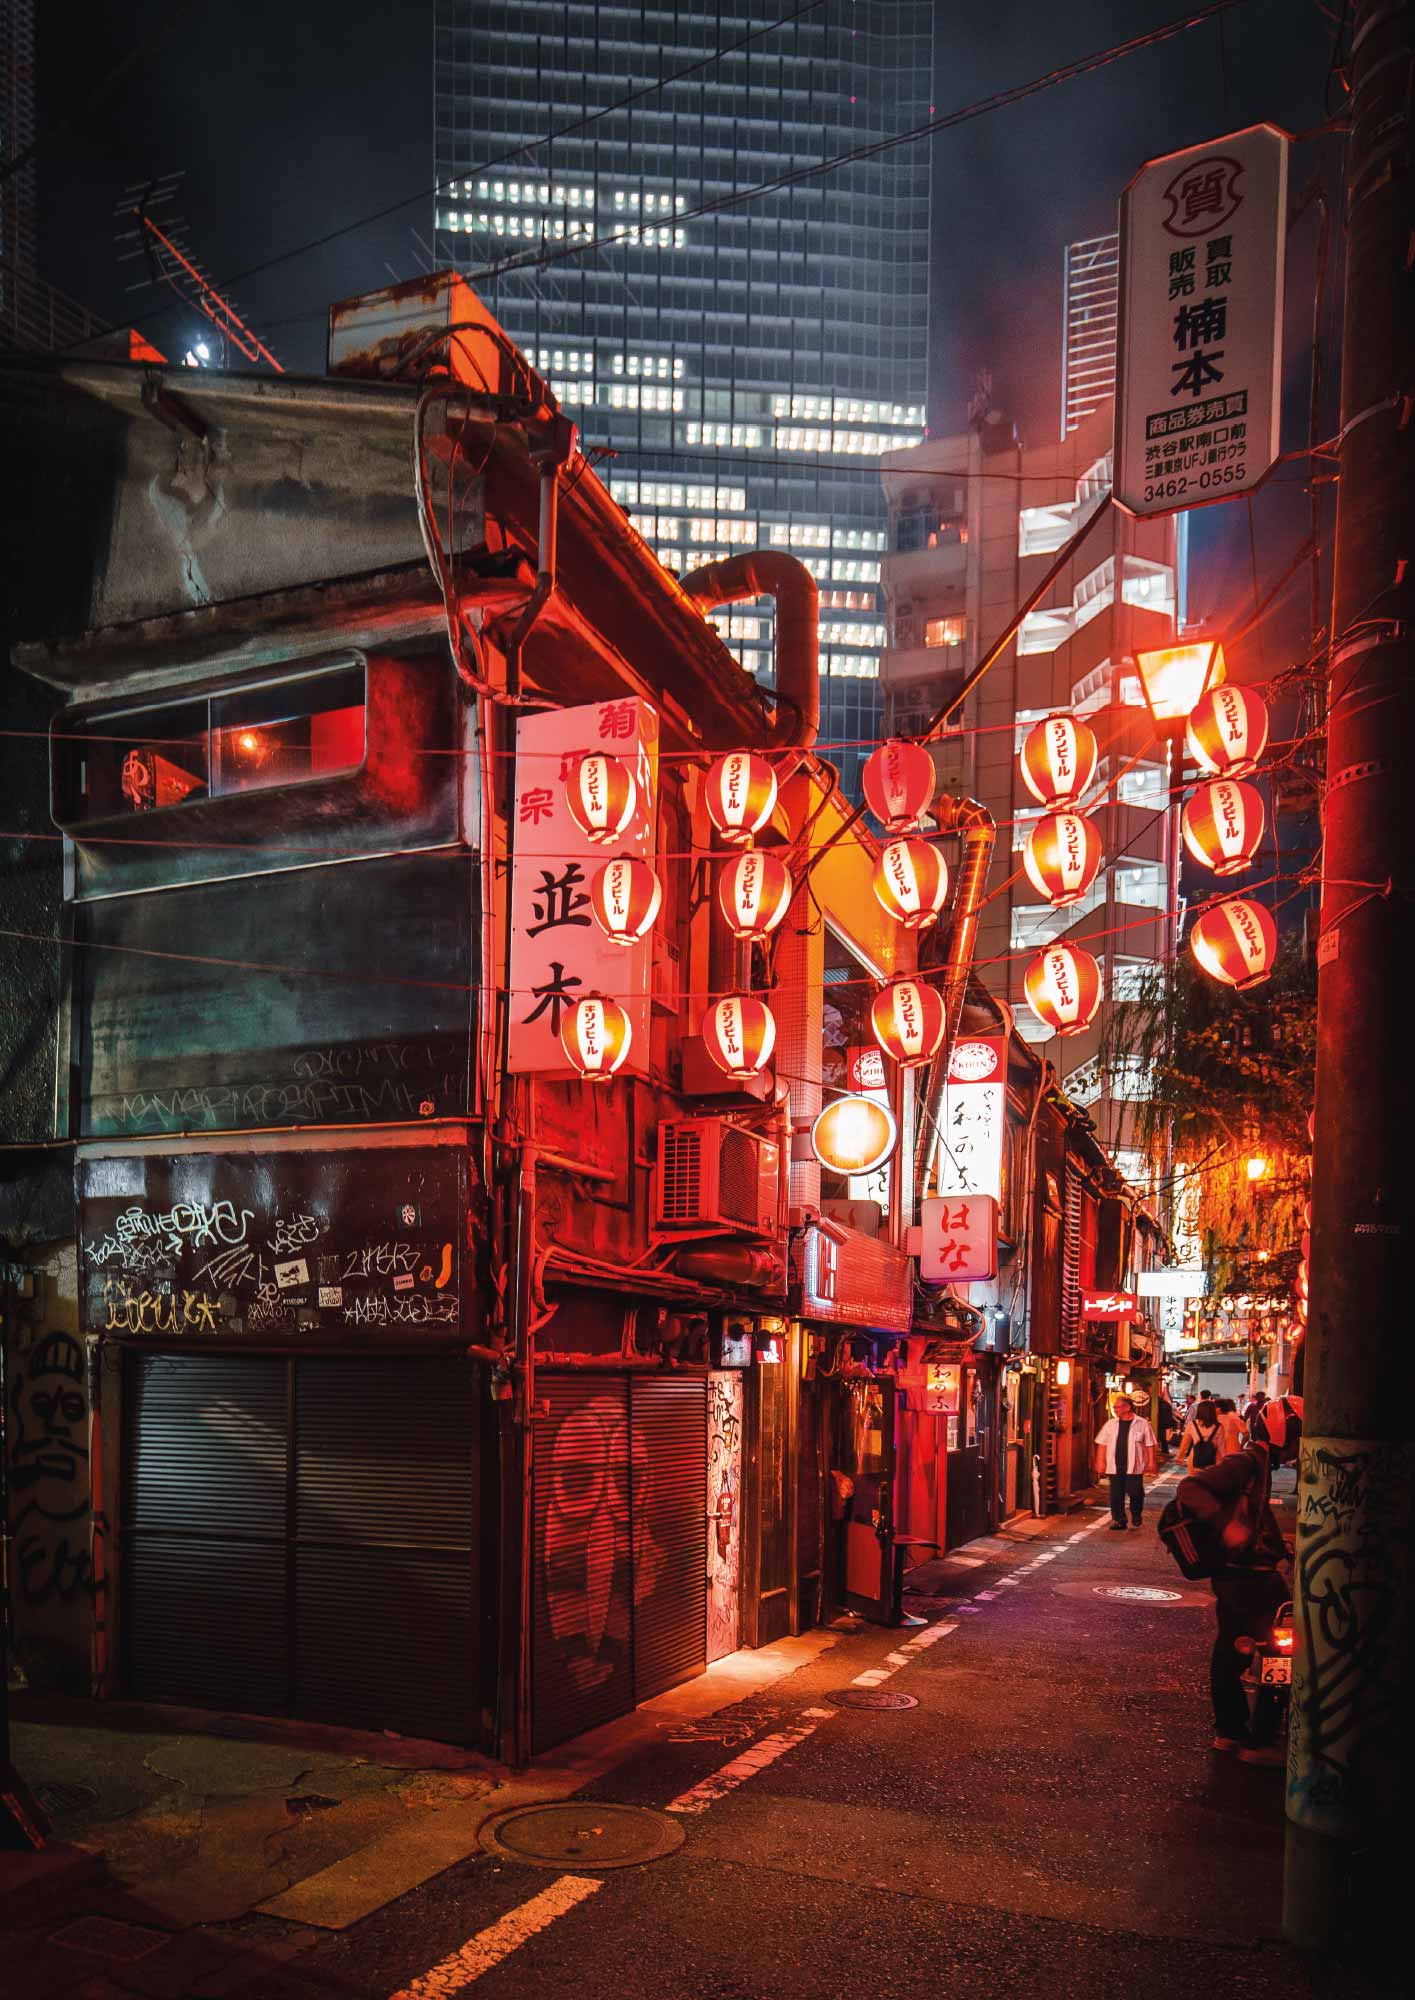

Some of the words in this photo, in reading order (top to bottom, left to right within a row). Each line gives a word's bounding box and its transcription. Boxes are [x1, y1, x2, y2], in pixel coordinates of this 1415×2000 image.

[1181, 168, 1226, 225] 質
[1168, 246, 1196, 301] 販売
[1205, 234, 1232, 288] 買取
[1170, 296, 1228, 398] 楠本
[1145, 422, 1246, 462] 渋谷駅南口前
[1150, 394, 1244, 437] 商品券売買
[1144, 462, 1246, 502] 3462-0555
[1219, 690, 1242, 741] キリンビール
[1053, 722, 1070, 777] キリンビール
[588, 760, 602, 812] キリンビール
[728, 756, 743, 810] キリンビール
[1216, 785, 1240, 839] キリンビール
[889, 846, 911, 897] キリンビール
[1063, 818, 1081, 872] キリンビール
[611, 864, 625, 916] キリンビール
[741, 857, 757, 910] キリンビール
[1051, 954, 1074, 1007] キリンビール
[583, 1004, 599, 1056] キリンビール
[722, 1001, 740, 1055] キリンビール
[898, 985, 919, 1040] キリンビール
[939, 1203, 971, 1272] はな
